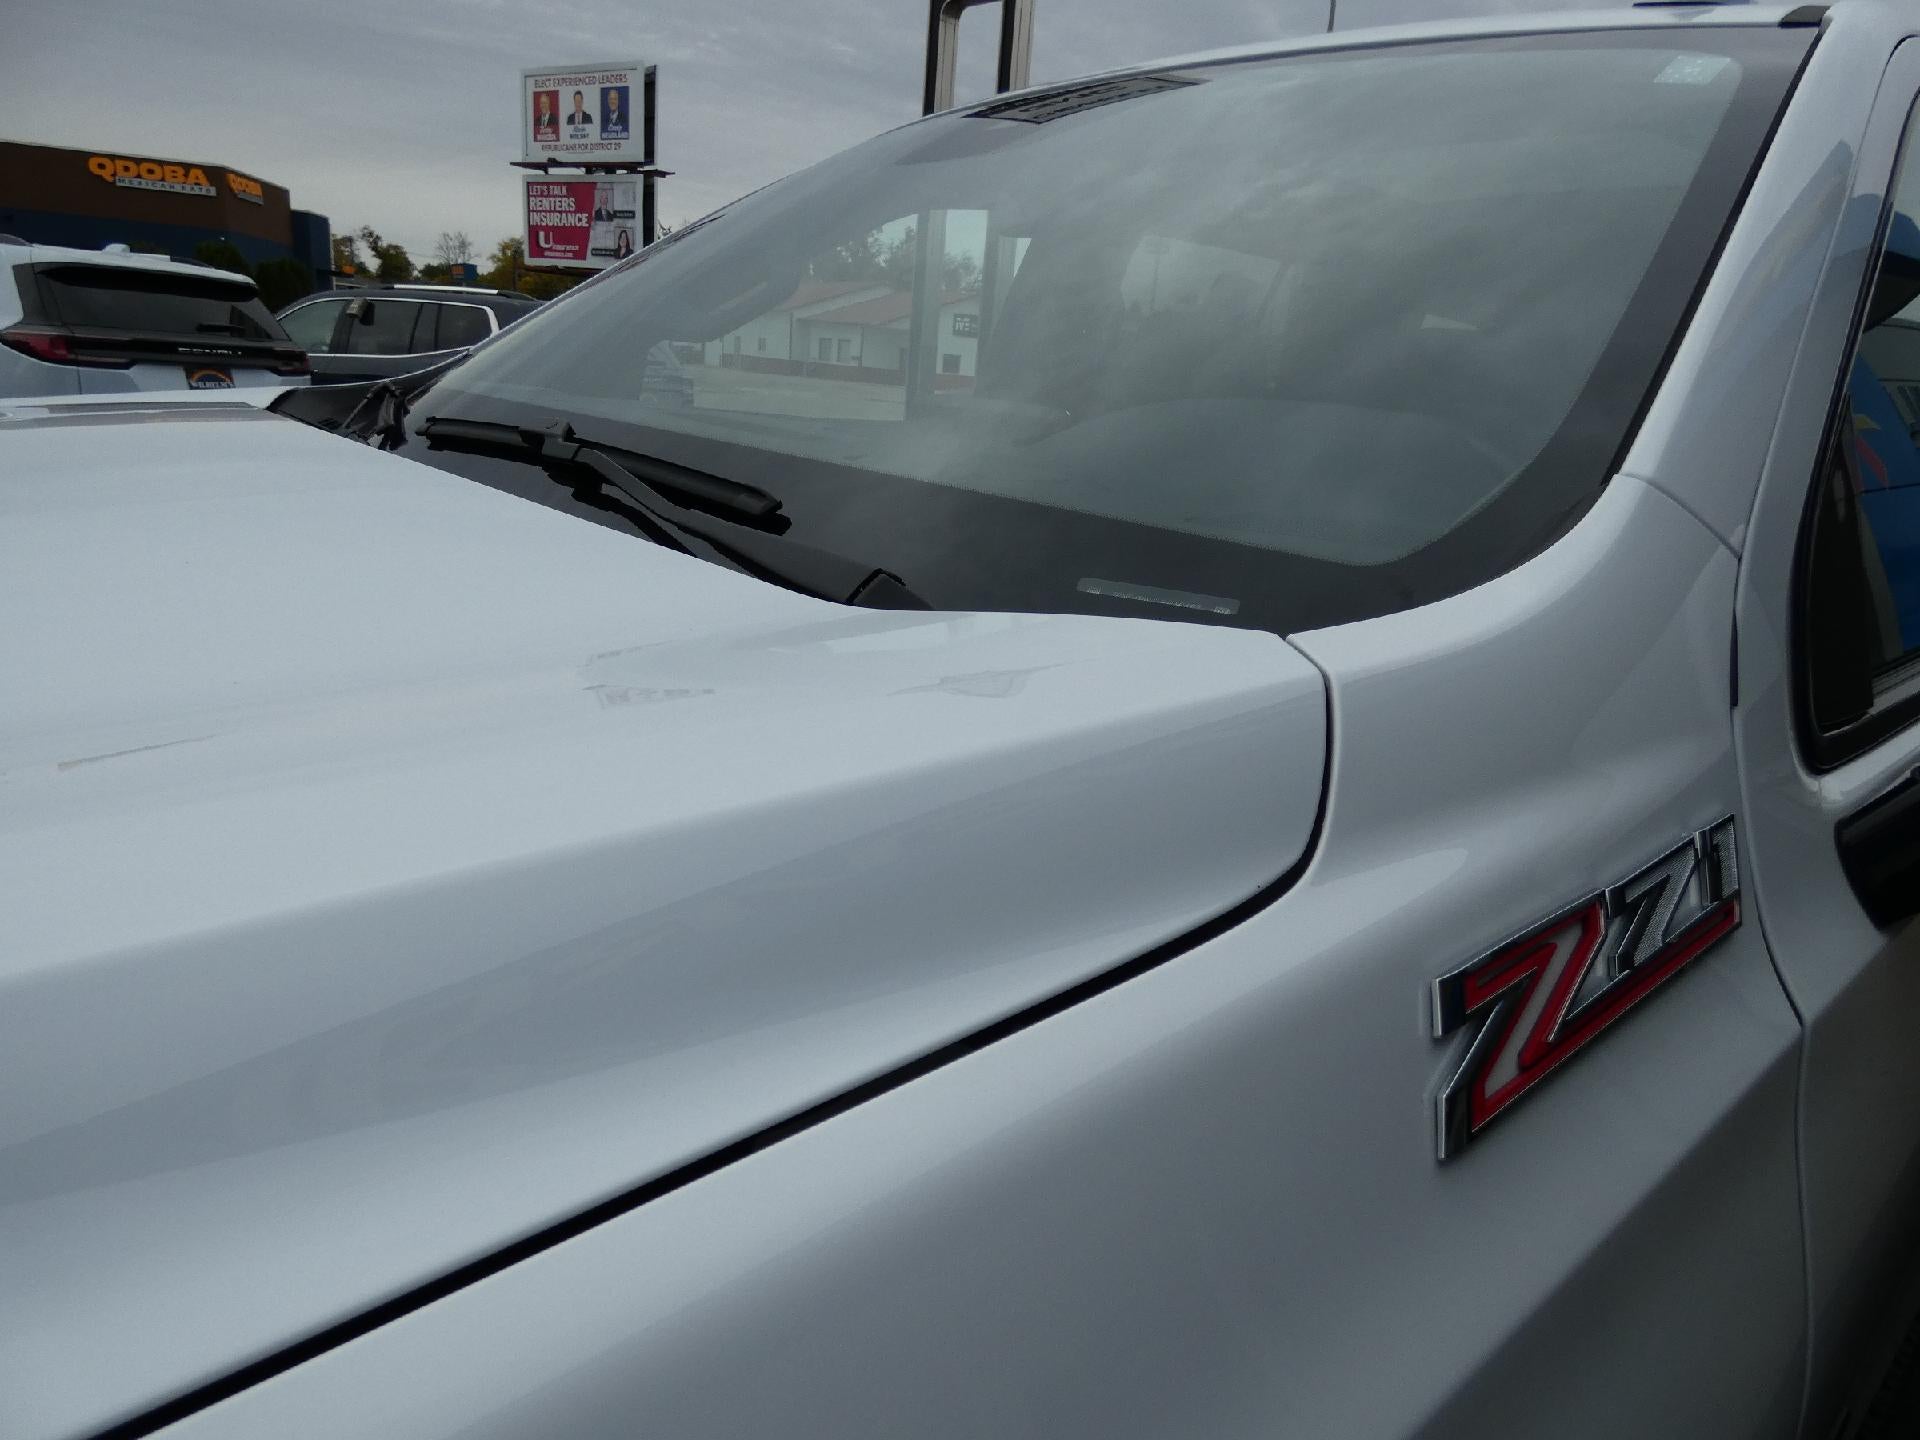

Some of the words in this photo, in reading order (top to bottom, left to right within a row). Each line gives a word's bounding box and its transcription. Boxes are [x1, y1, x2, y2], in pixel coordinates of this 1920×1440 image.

[534, 78, 552, 89] ELECT
[553, 75, 597, 88] EXPERIENCED
[598, 73, 628, 85] LEADERS
[541, 143, 577, 152] REPUBLICANS
[578, 143, 589, 151] FOR
[589, 142, 613, 151] DISTRICT
[88, 156, 211, 187] QDOBA
[529, 185, 549, 195] LET'S
[549, 185, 567, 195] TALK
[529, 197, 576, 211] RENTERS
[529, 212, 589, 227] INSURANCE
[1431, 813, 1741, 1160] Z71
